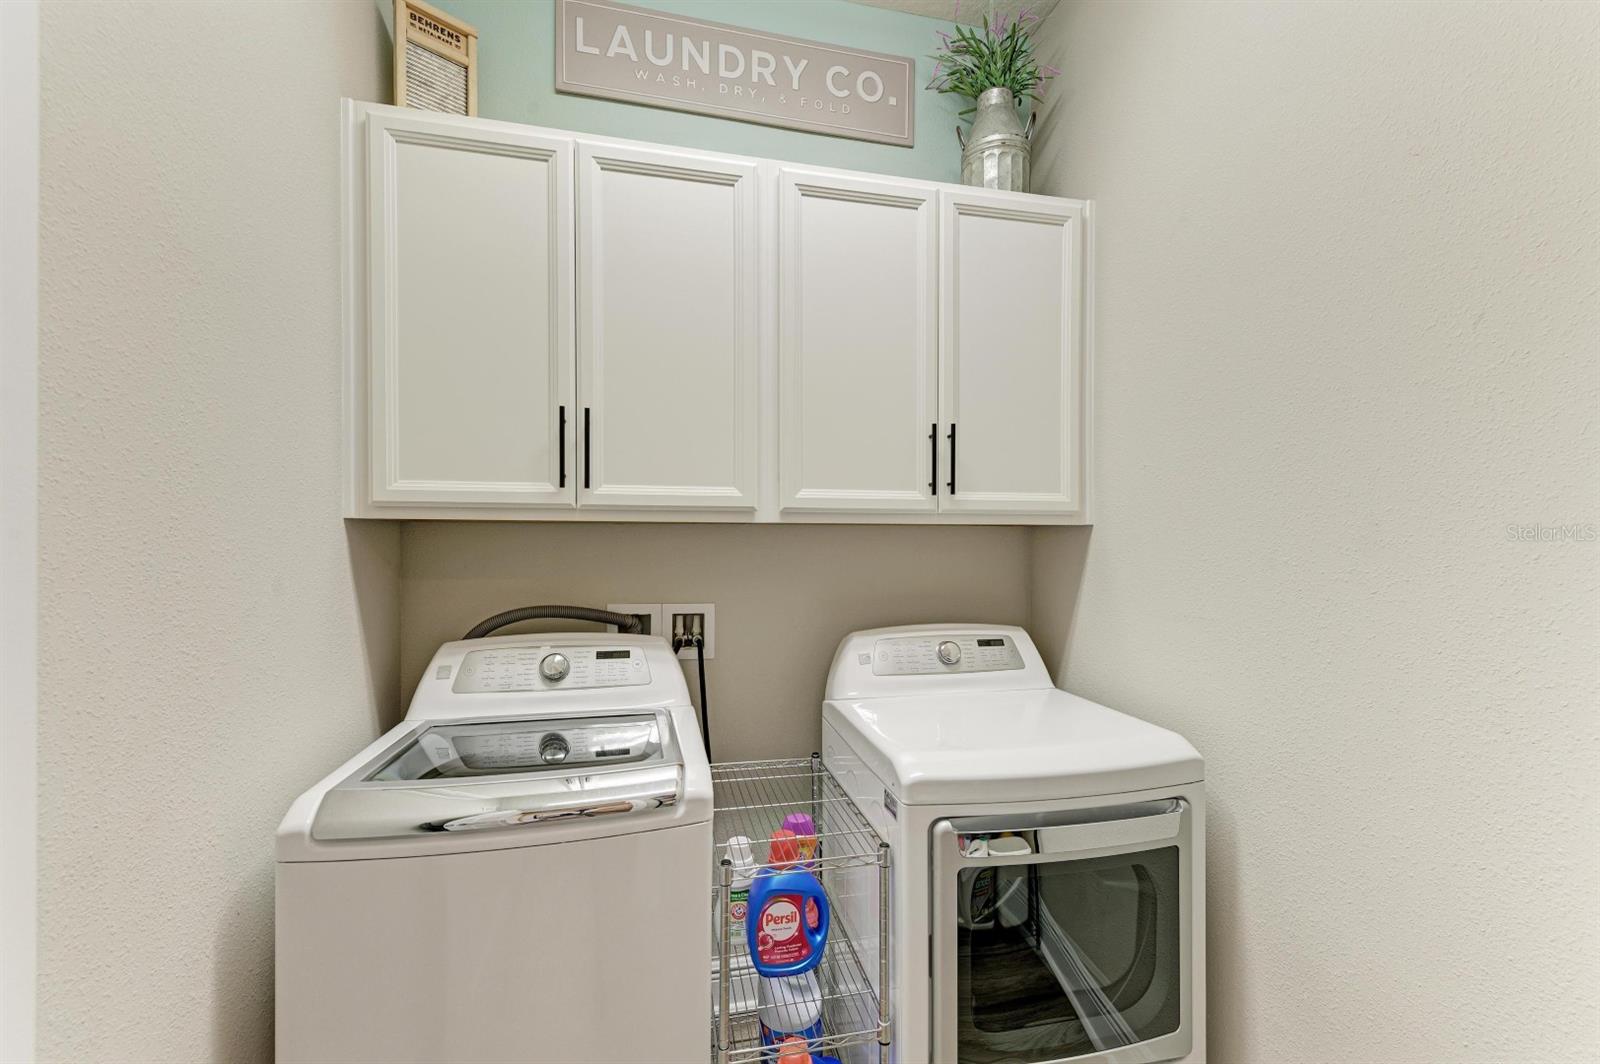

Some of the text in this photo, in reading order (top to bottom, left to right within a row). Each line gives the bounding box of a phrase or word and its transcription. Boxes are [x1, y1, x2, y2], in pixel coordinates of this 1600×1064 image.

[410, 12, 461, 43] BEHRENS
[575, 16, 897, 106] LAUNDRY CO.
[719, 83, 766, 103] DRY,
[800, 97, 851, 114] FOLD
[766, 911, 797, 926] Persil
